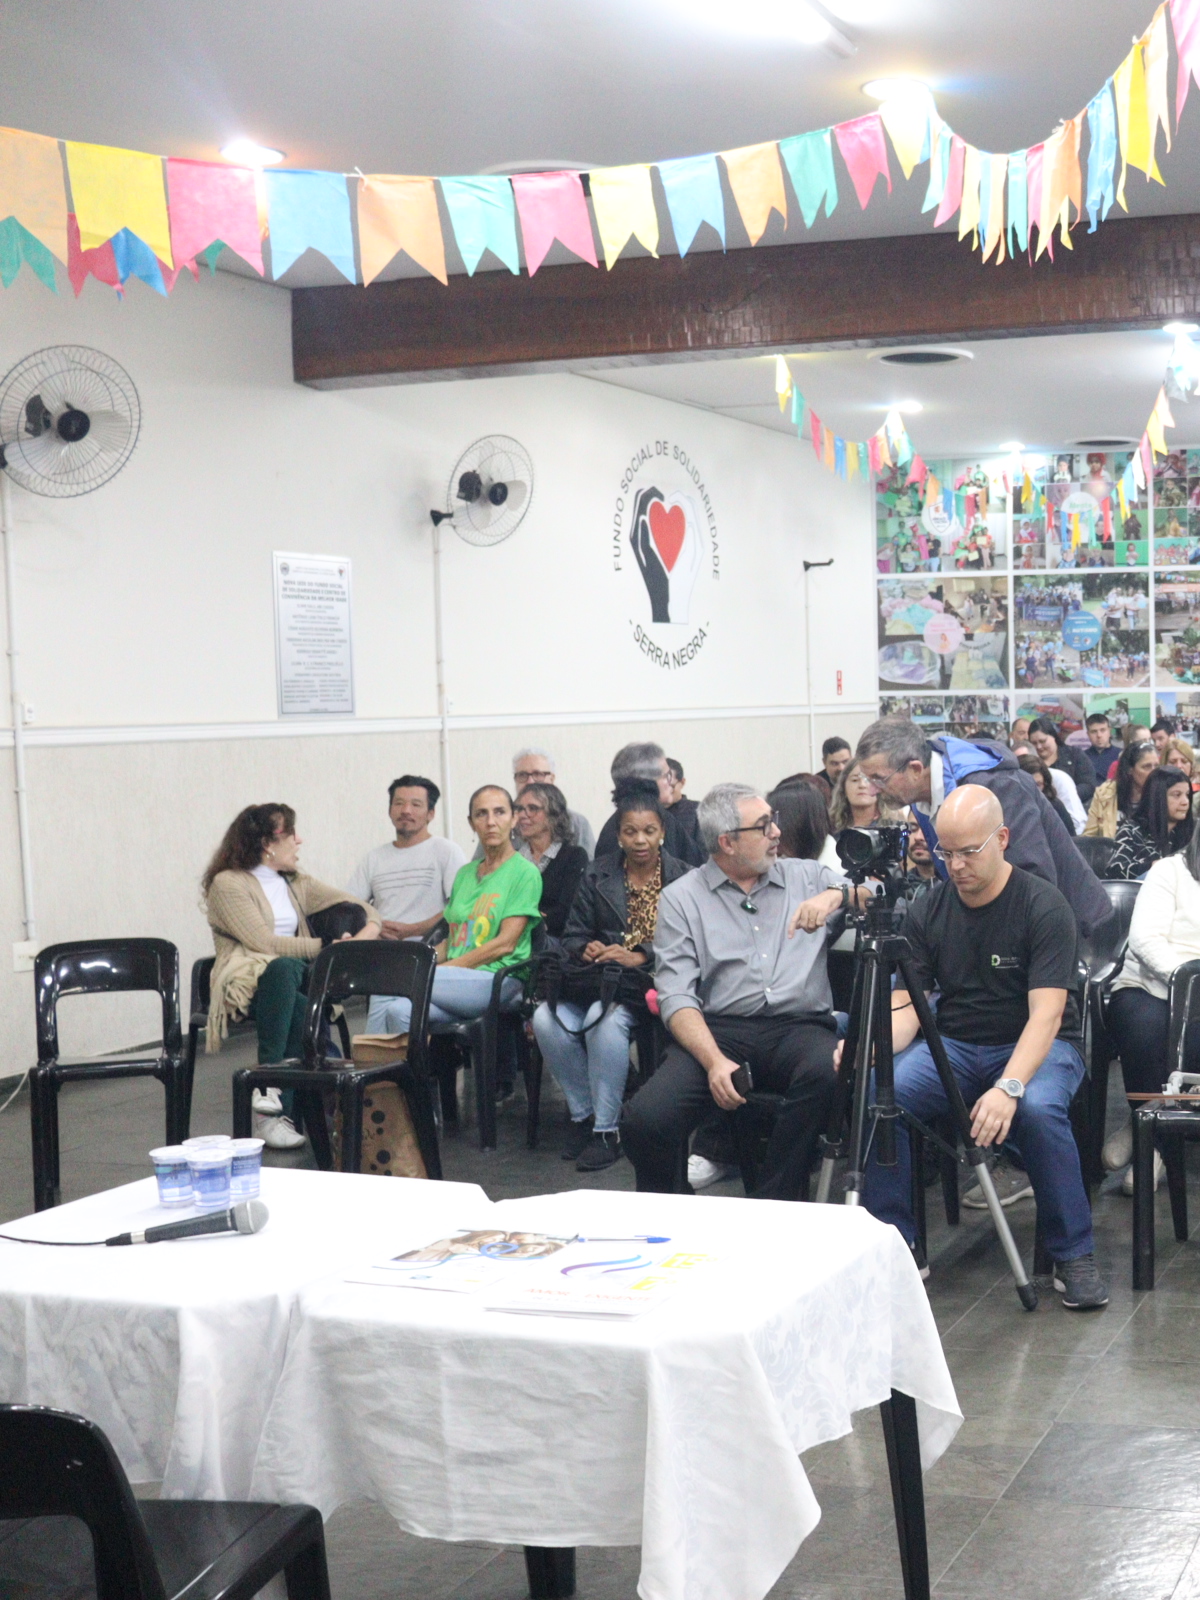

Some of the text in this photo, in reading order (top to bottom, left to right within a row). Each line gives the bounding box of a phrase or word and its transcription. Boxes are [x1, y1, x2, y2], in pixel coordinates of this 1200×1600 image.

[613, 440, 720, 581] FUNDO SOCIAL DE SOLIDARIEDADE
[633, 624, 708, 670] SERRA NEGRA
